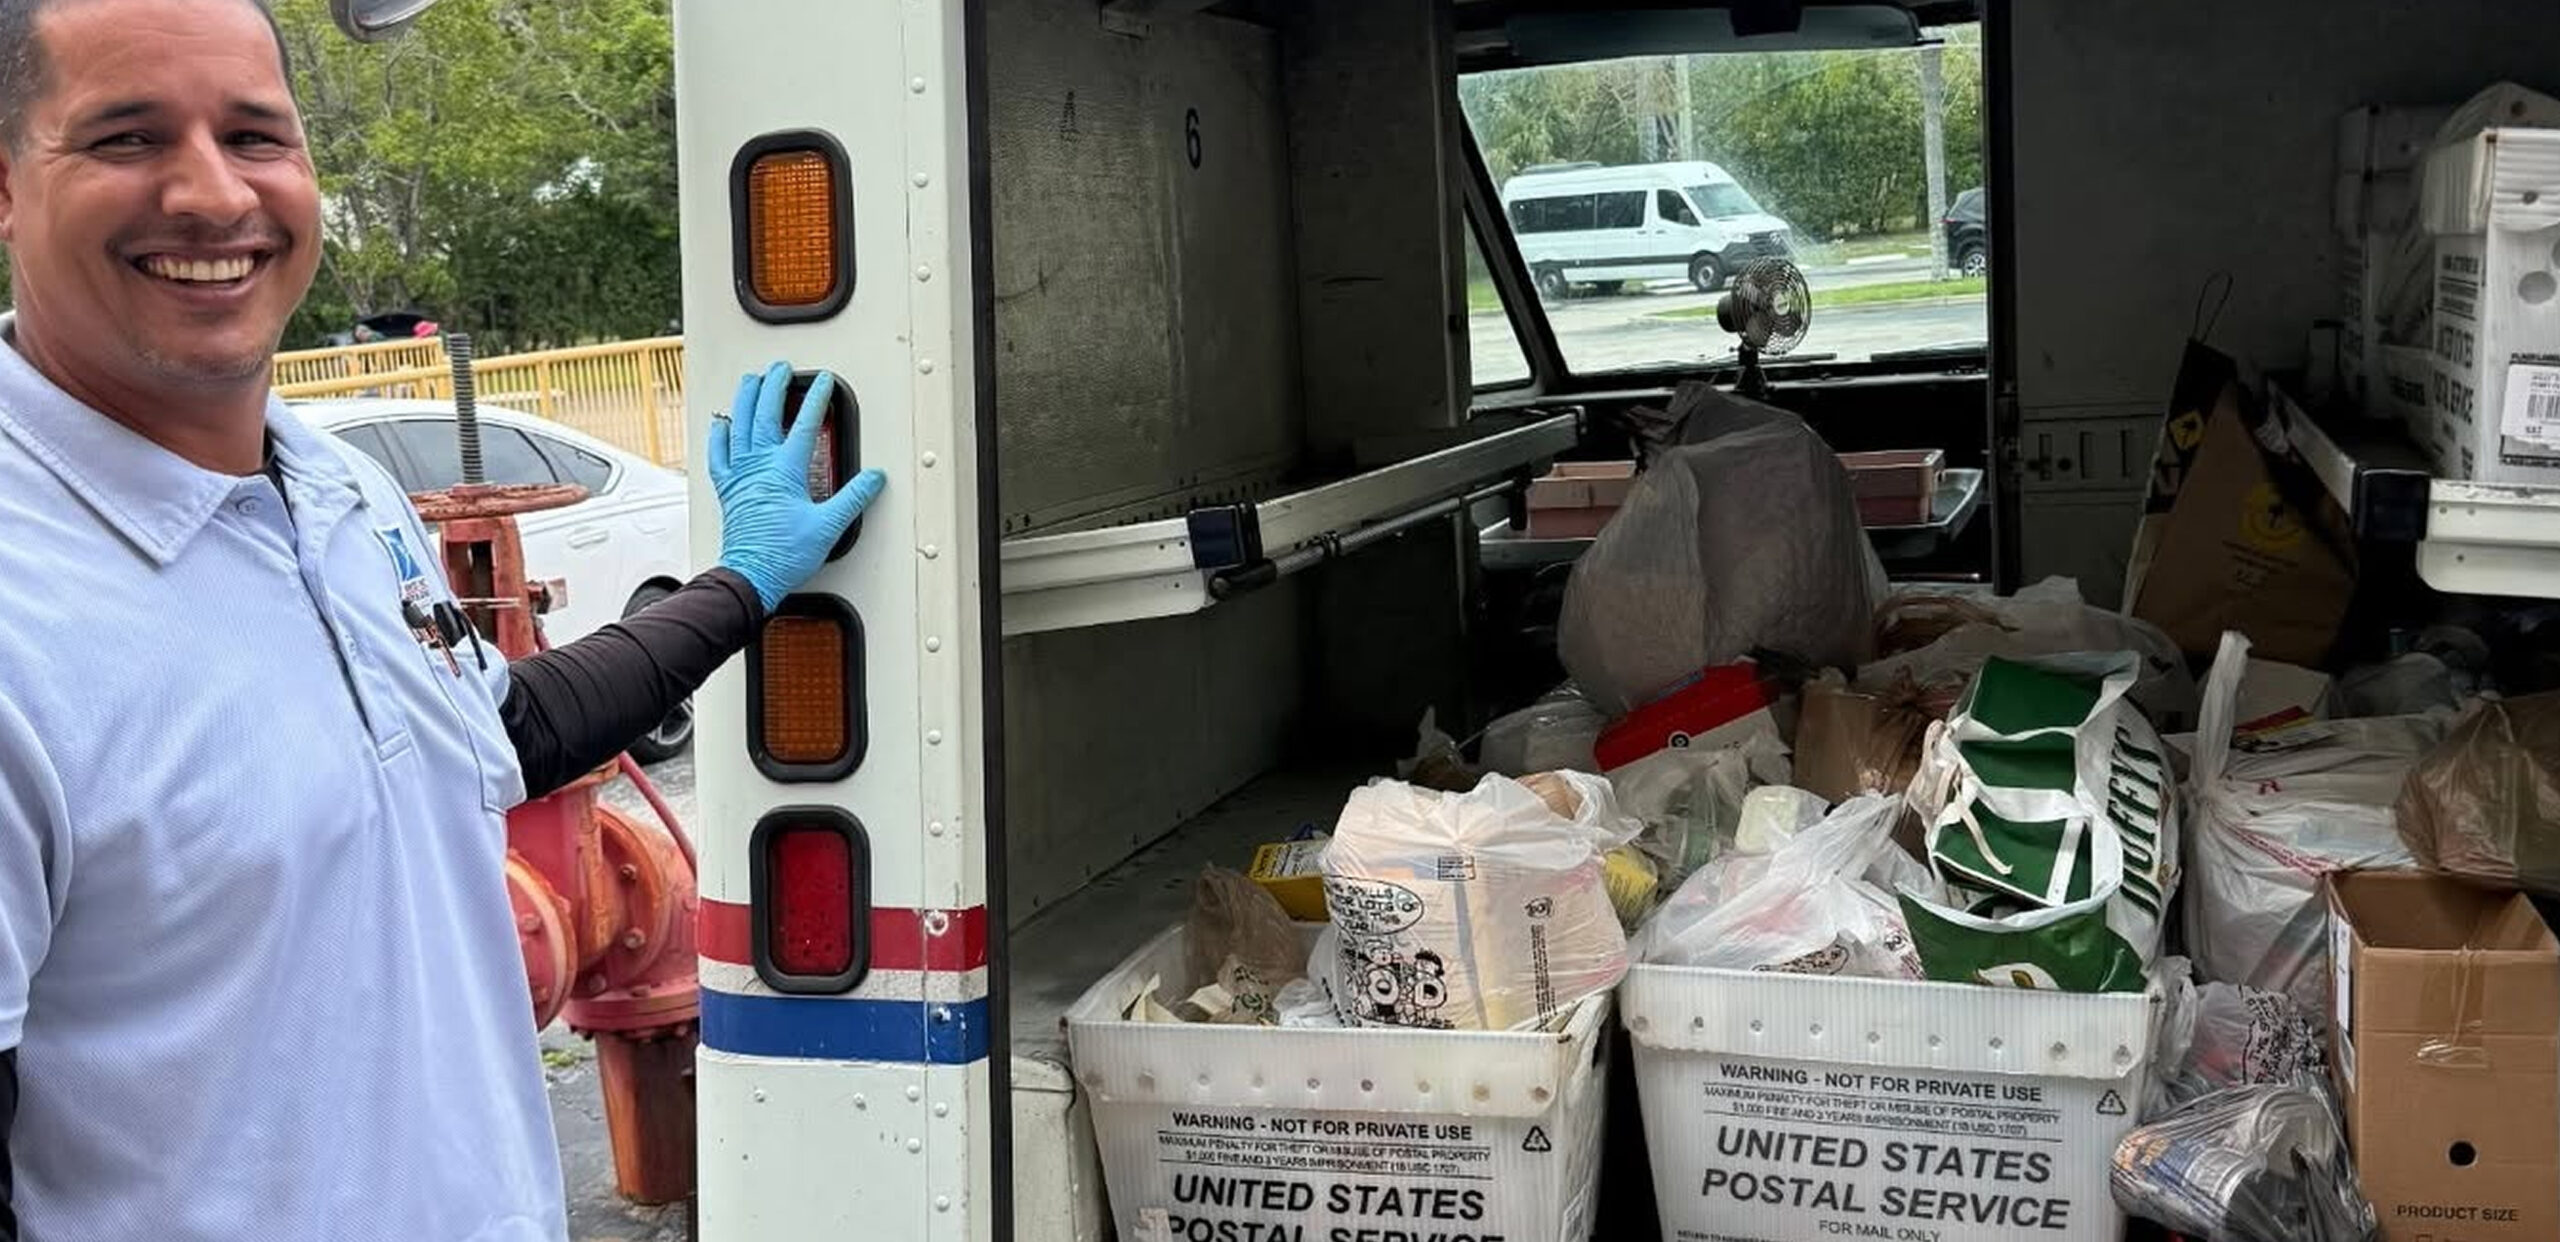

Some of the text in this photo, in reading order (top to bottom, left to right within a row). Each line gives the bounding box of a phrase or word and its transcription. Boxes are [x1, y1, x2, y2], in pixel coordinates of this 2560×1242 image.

[1186, 107, 1200, 169] 6
[1720, 1062, 1808, 1085] WARNING
[1825, 1072, 1864, 1089] NOT
[1870, 1076, 1909, 1093] FOR
[1916, 1079, 1996, 1099] PRIVATE
[2003, 1085, 2042, 1102] USE
[1806, 1095, 1830, 1107] FOR
[1833, 1097, 1866, 1109] THEFT
[1868, 1101, 1886, 1112] OR
[1932, 1105, 1948, 1117] OF
[1951, 1106, 1994, 1120] POSTAL
[1997, 1110, 2061, 1124] PROPERTY
[1825, 1110, 1861, 1122] YEARS
[1173, 1112, 1255, 1131] WARNING
[1271, 1118, 1307, 1134] NOT
[1313, 1120, 1349, 1135] FOR
[1356, 1122, 1429, 1139] PRIVATE
[1436, 1125, 1473, 1141] USE
[1272, 1154, 1307, 1167] YEARS
[1389, 1148, 1429, 1160] POSTAL
[1432, 1149, 1491, 1162] PROPERTY
[1717, 1125, 2052, 1183] UNITED STATES
[1174, 1173, 1485, 1221] UNITED STATES
[1702, 1168, 2070, 1230] POSTAL SERVICE
[2397, 1205, 2520, 1222] PRODUCT SIZE
[1820, 1219, 1942, 1242] FOR MAIL ONLY
